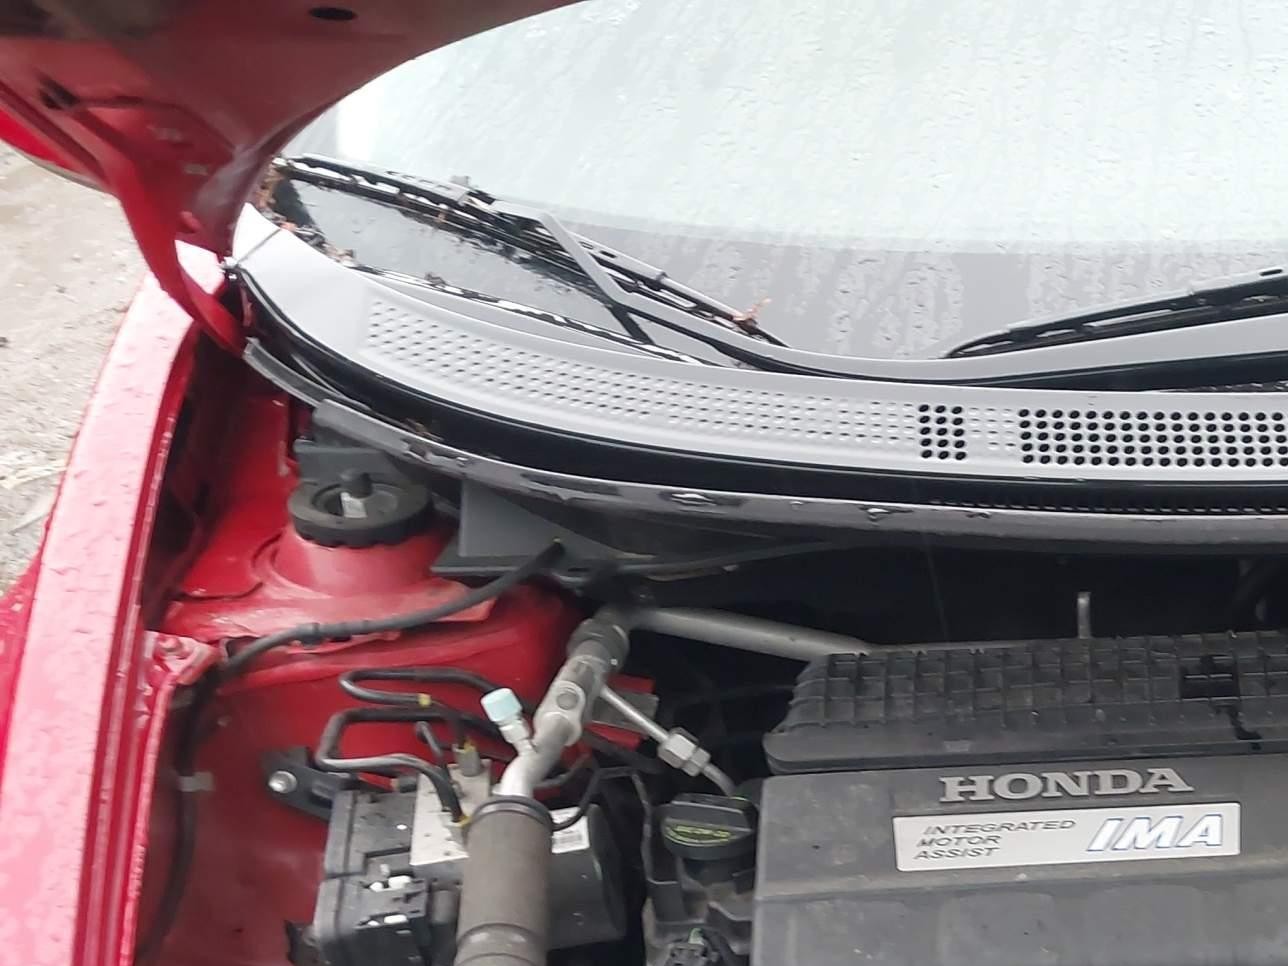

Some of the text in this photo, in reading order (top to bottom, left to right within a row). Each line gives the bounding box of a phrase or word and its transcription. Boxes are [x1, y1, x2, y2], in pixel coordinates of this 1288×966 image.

[939, 767, 1194, 803] HONDA
[923, 819, 1077, 836] INTEGRATED
[1086, 813, 1225, 852] IMA
[918, 834, 1002, 848] MOTOR
[914, 846, 1001, 861] ASSIST
